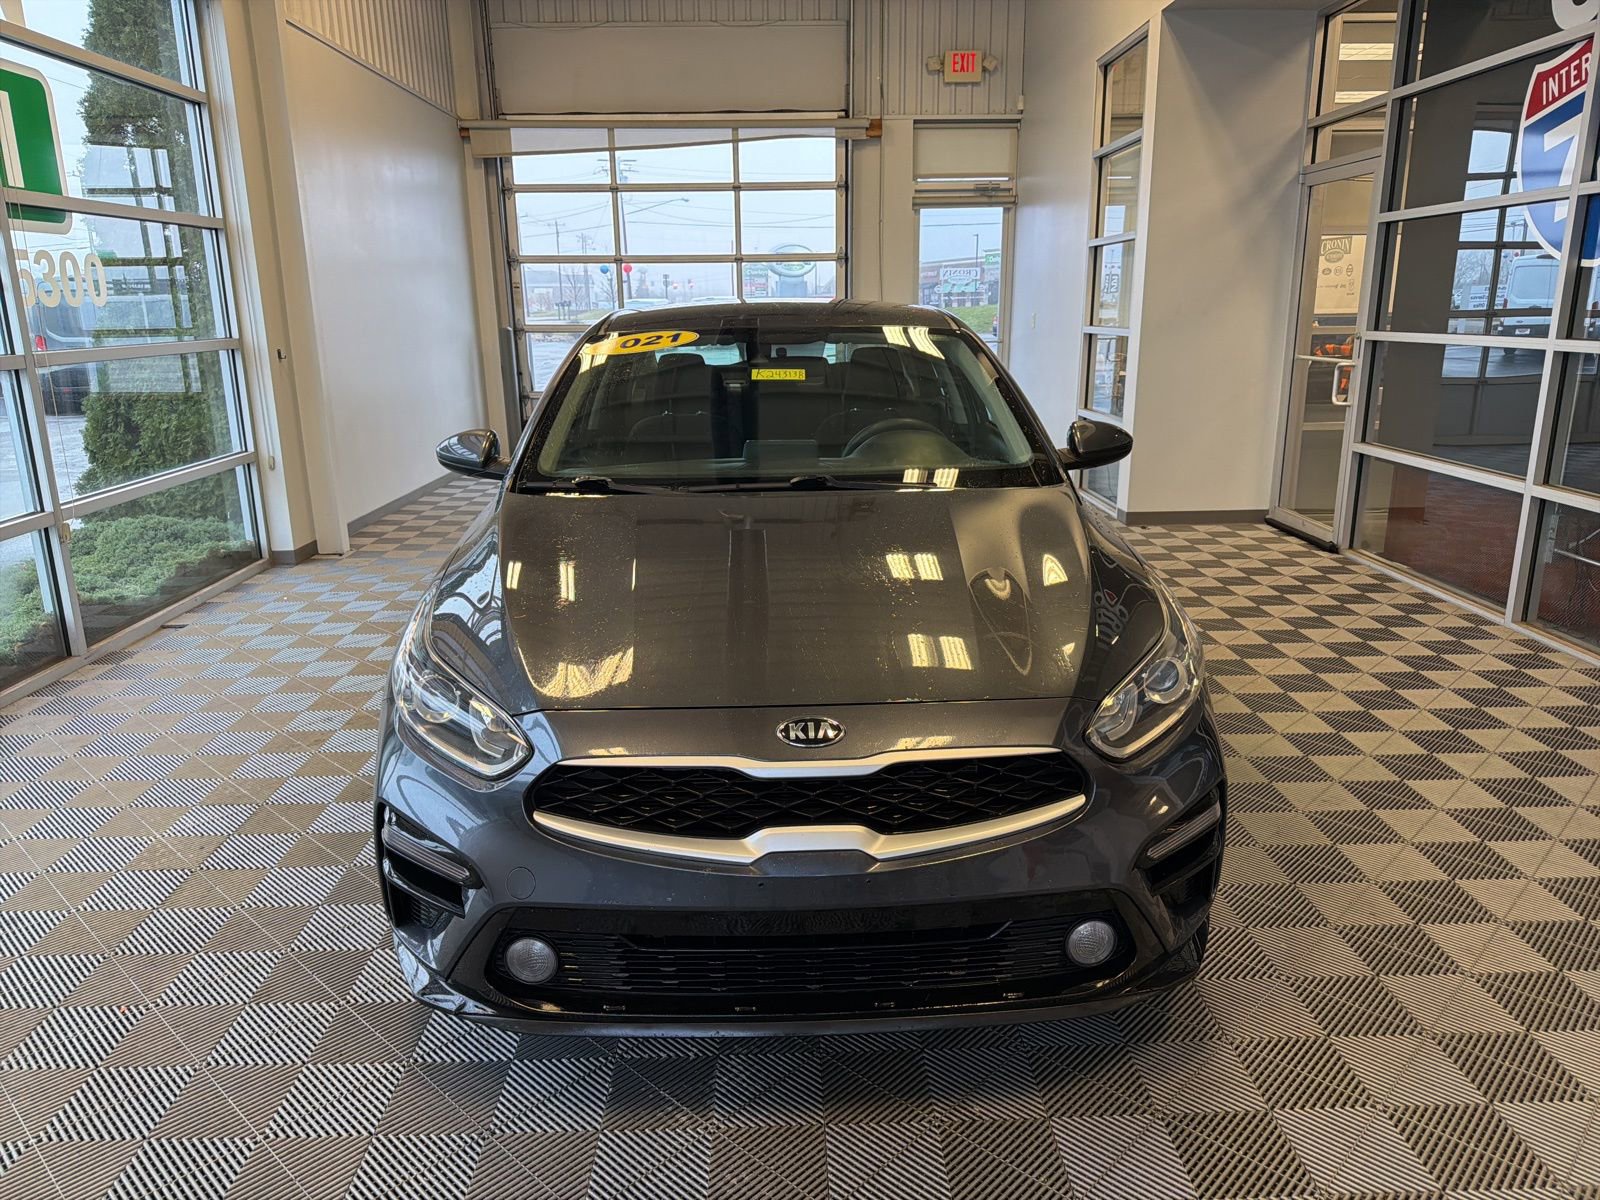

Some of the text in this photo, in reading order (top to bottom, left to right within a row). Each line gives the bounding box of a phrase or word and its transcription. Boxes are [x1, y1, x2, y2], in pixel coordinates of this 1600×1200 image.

[952, 52, 977, 73] EXIT
[1321, 238, 1351, 254] CRONIN
[14, 249, 108, 308] 5300
[604, 333, 682, 351] 021
[788, 721, 839, 740] KIA
